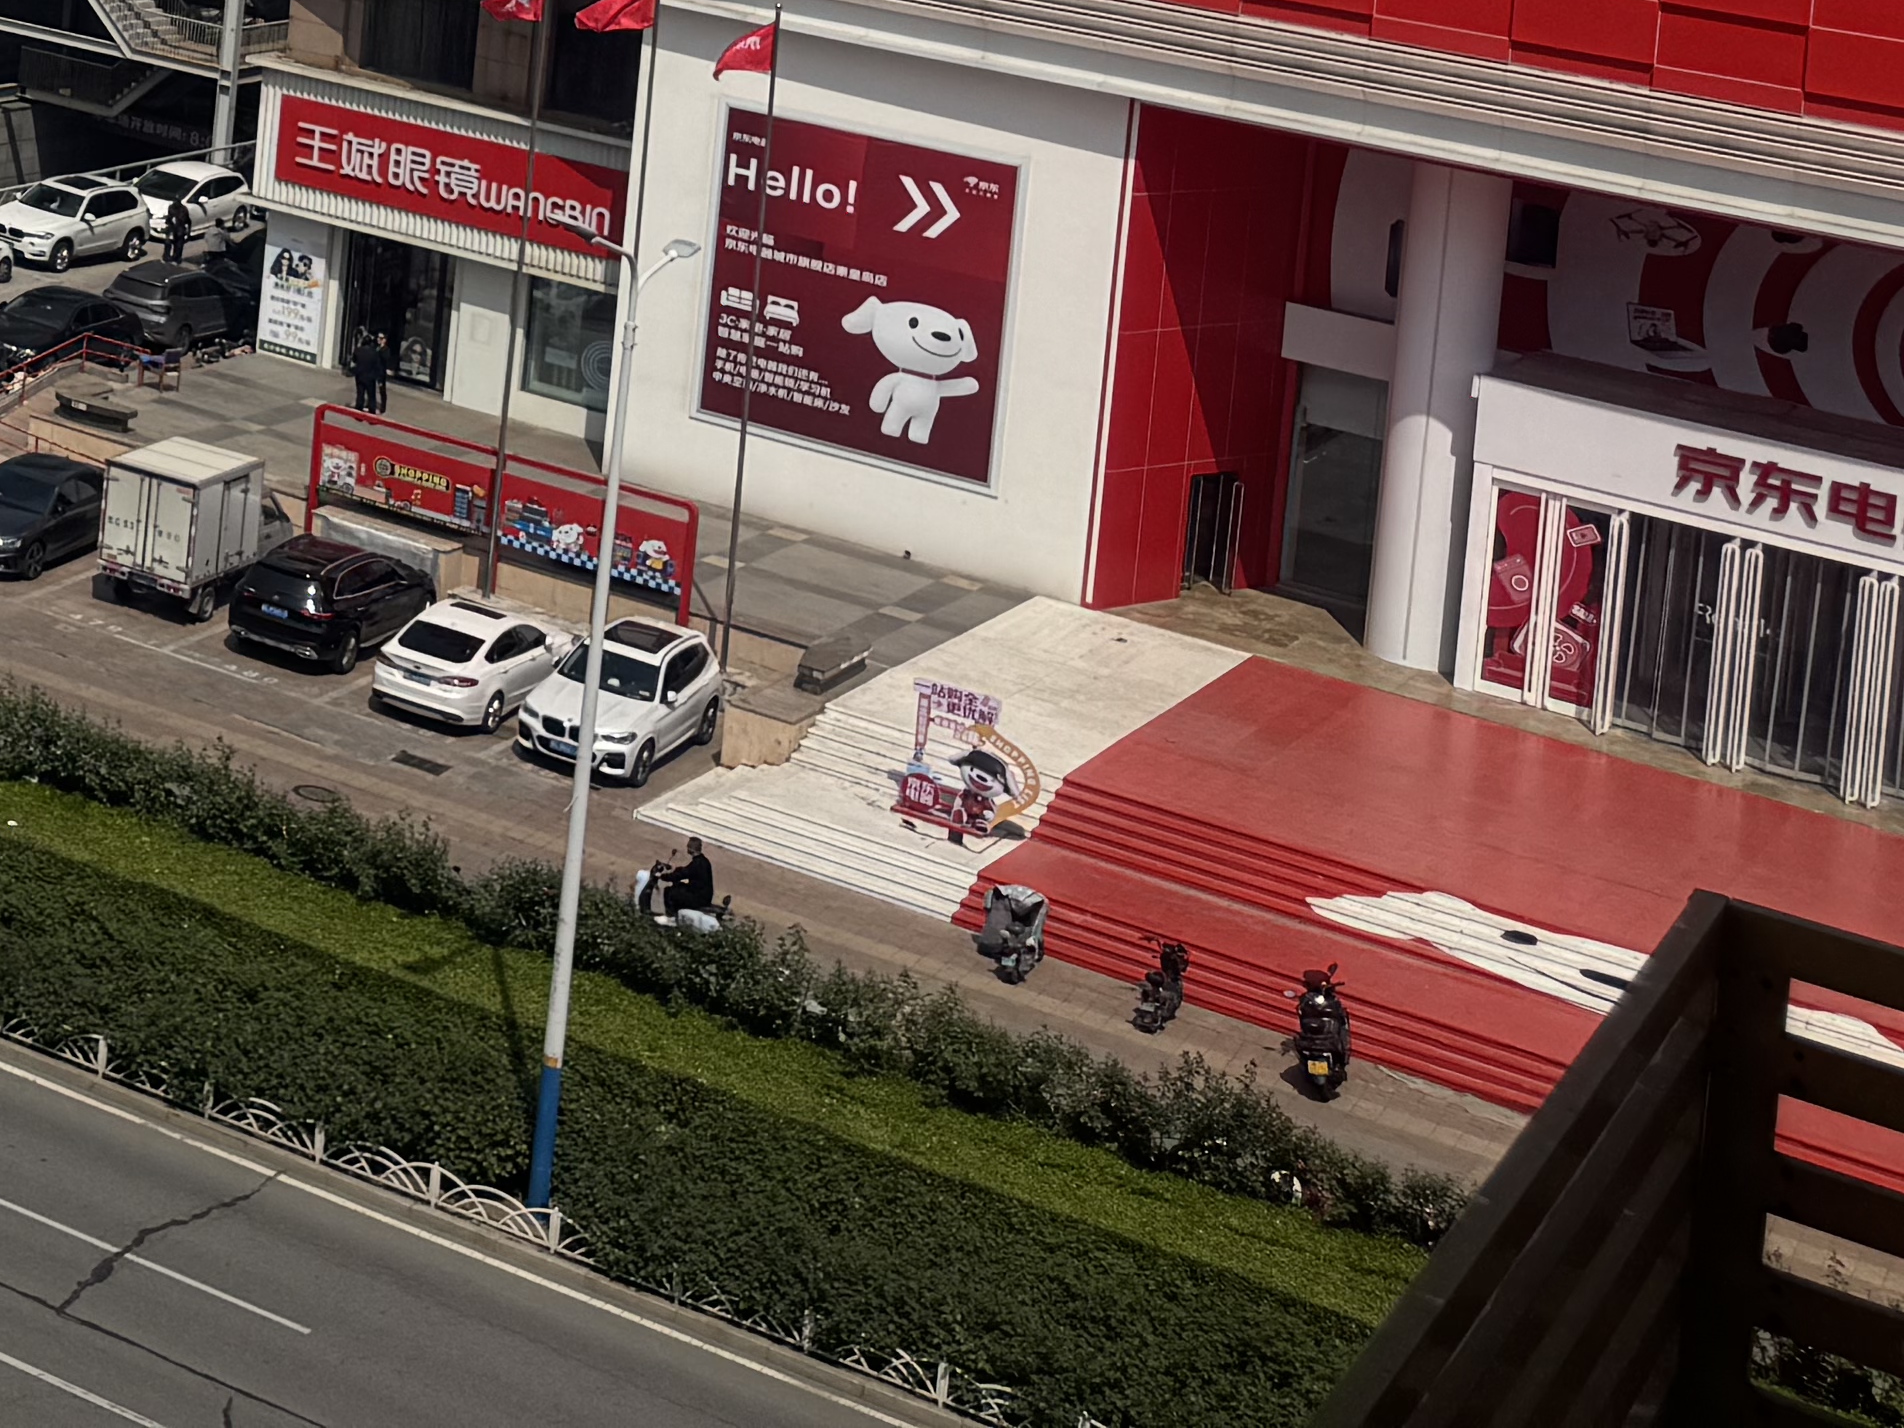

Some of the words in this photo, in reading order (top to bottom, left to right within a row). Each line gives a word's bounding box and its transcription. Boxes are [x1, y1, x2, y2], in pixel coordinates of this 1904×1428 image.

[295, 119, 482, 208] 王斌眼镜
[726, 152, 858, 215] Hello!
[1671, 442, 1904, 544] 京东电
